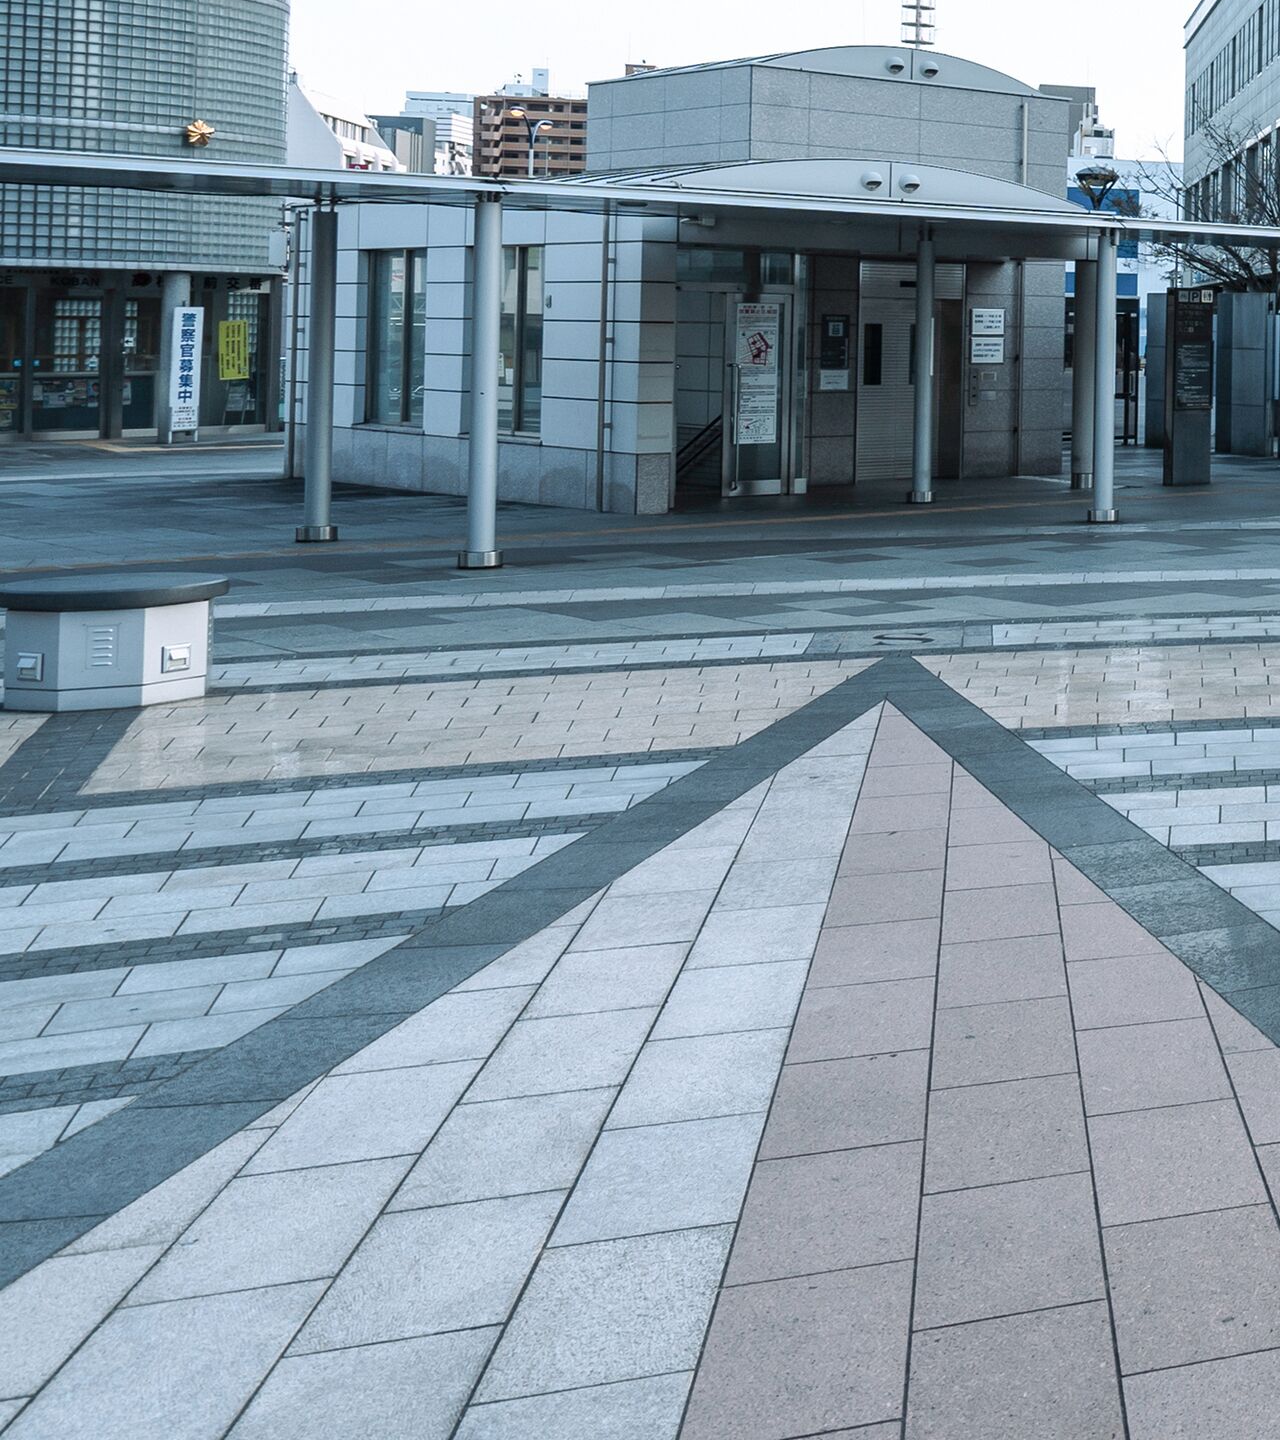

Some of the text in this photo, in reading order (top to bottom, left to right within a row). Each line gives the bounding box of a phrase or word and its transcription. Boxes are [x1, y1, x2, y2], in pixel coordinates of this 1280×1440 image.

[178, 312, 197, 404] 警察官募集中
